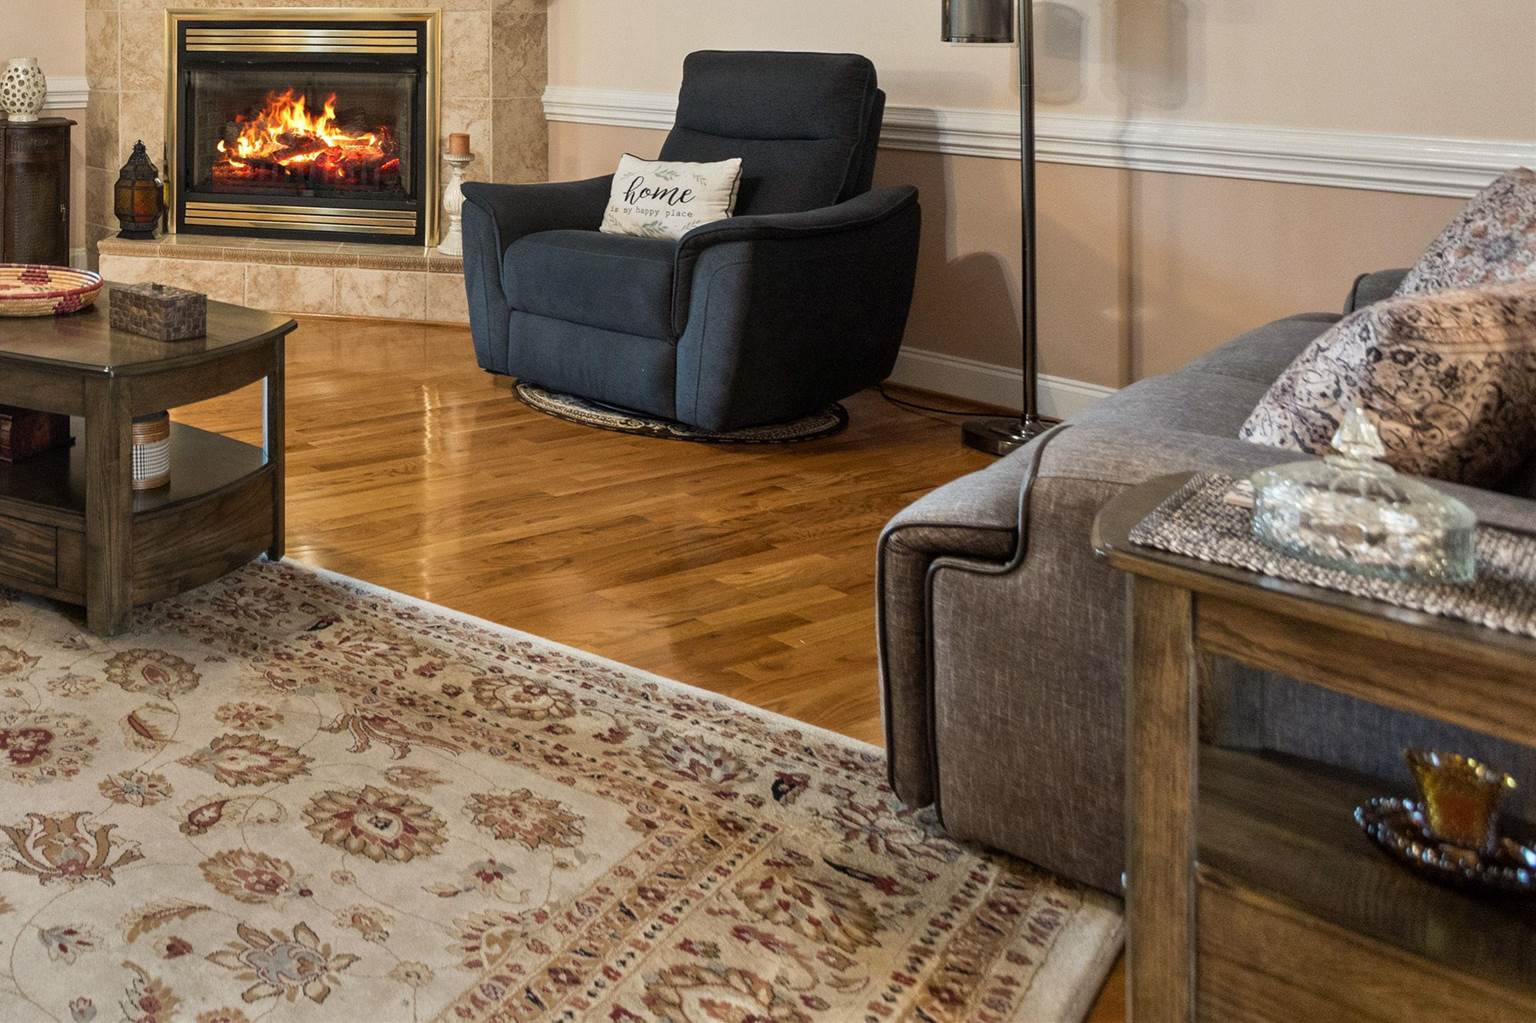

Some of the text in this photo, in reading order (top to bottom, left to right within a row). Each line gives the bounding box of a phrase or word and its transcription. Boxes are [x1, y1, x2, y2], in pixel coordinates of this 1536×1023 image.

[623, 176, 696, 206] home
[609, 205, 619, 213] is
[635, 206, 660, 217] happy
[665, 208, 694, 218] place
